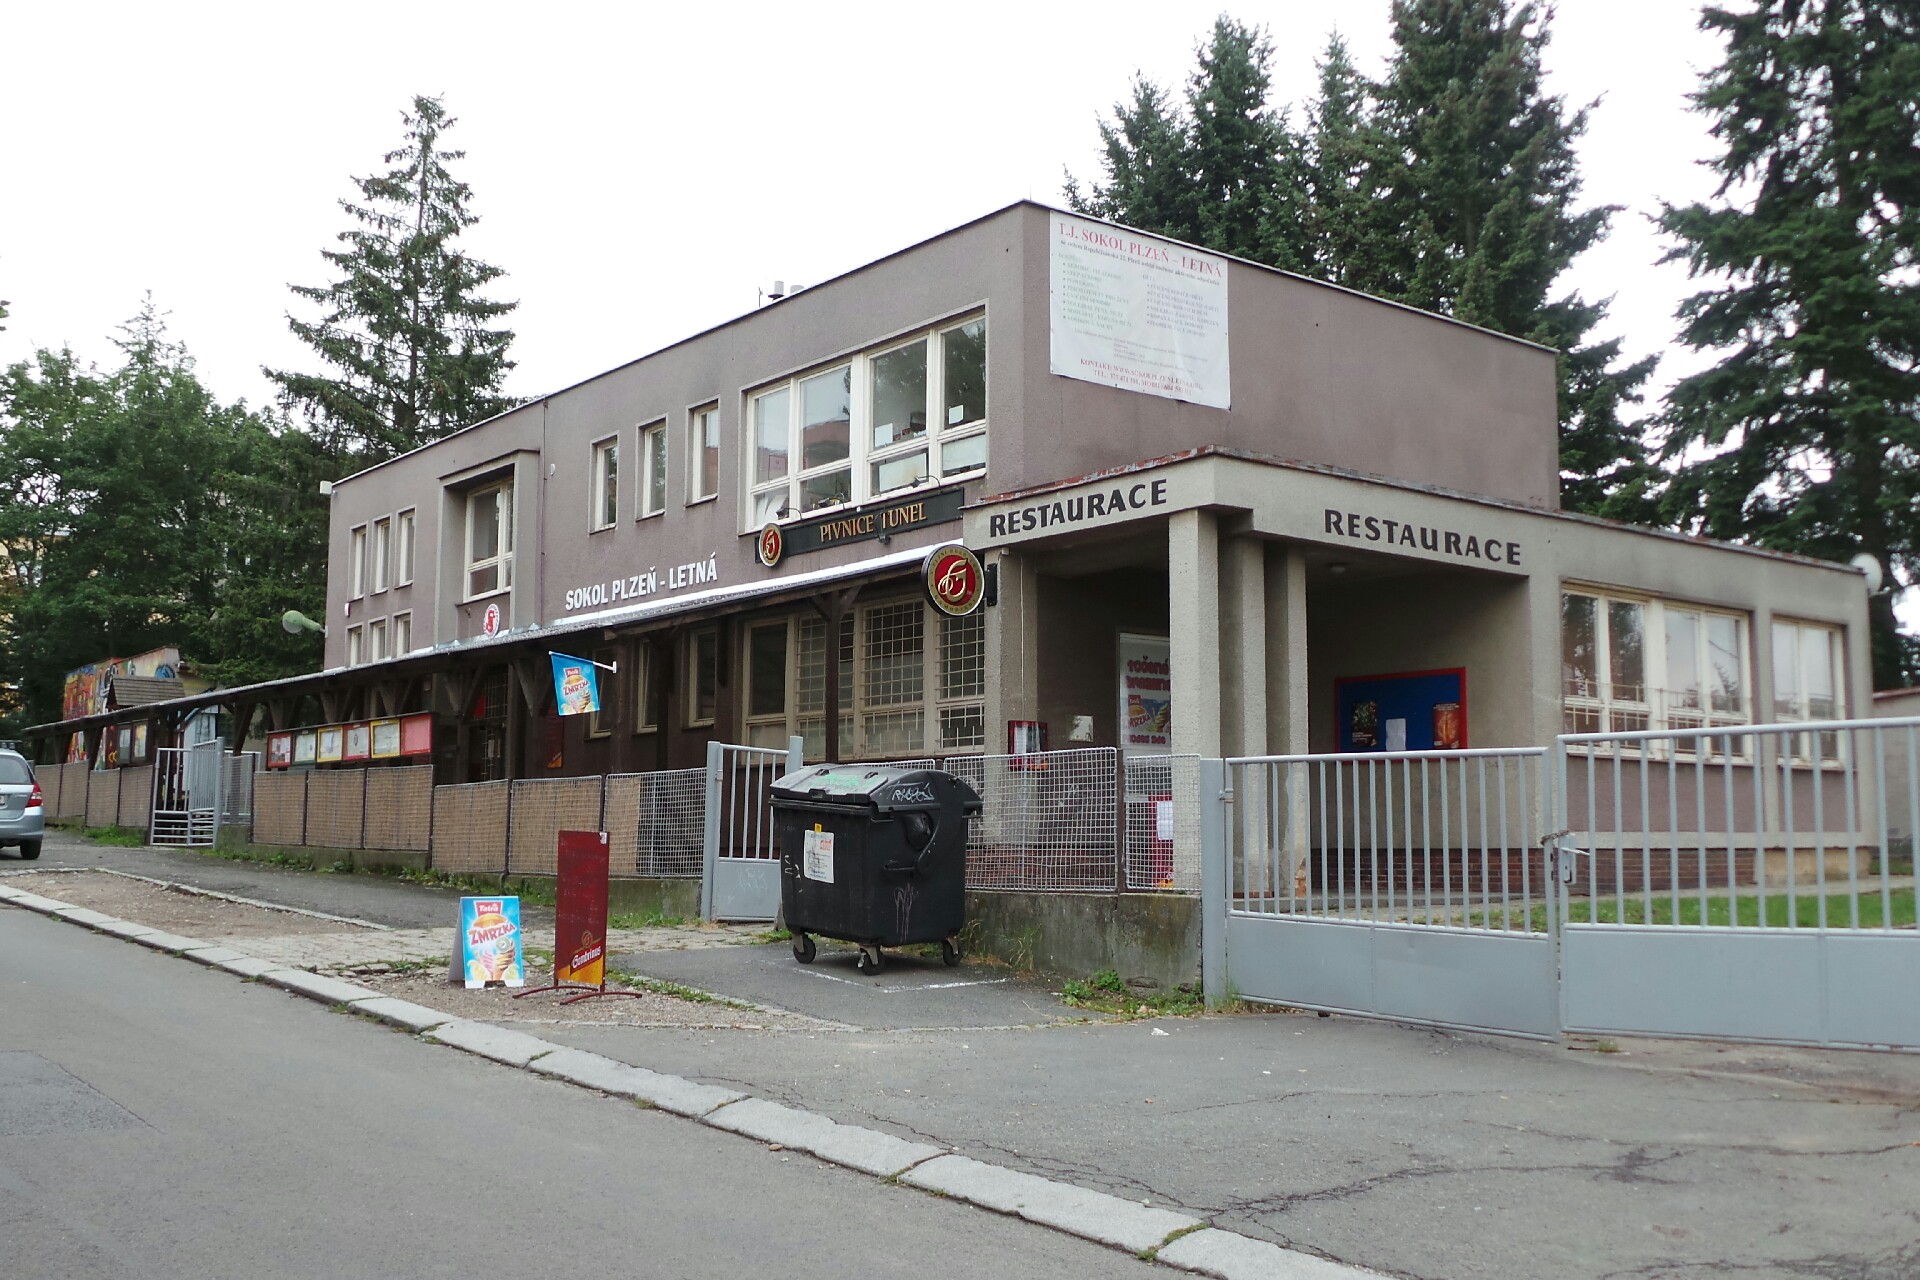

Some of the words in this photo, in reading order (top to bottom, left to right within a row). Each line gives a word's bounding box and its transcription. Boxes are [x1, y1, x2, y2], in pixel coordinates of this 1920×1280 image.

[1058, 223, 1078, 239] T.J.
[1082, 229, 1126, 254] SOKOL
[1130, 242, 1169, 263] PLZEŇ
[1182, 257, 1222, 278] LETNÁ
[820, 514, 874, 542] PIVNICE
[879, 502, 927, 527] TUNEL
[989, 478, 1167, 538] RESTAURACE
[1324, 509, 1521, 565] RESTAURACE
[565, 585, 608, 611] SOKOL
[612, 567, 656, 601] PLZEŇ
[669, 552, 717, 590] LETNÁ
[468, 923, 516, 945] ZMRZKA
[479, 904, 499, 912] Tatra
